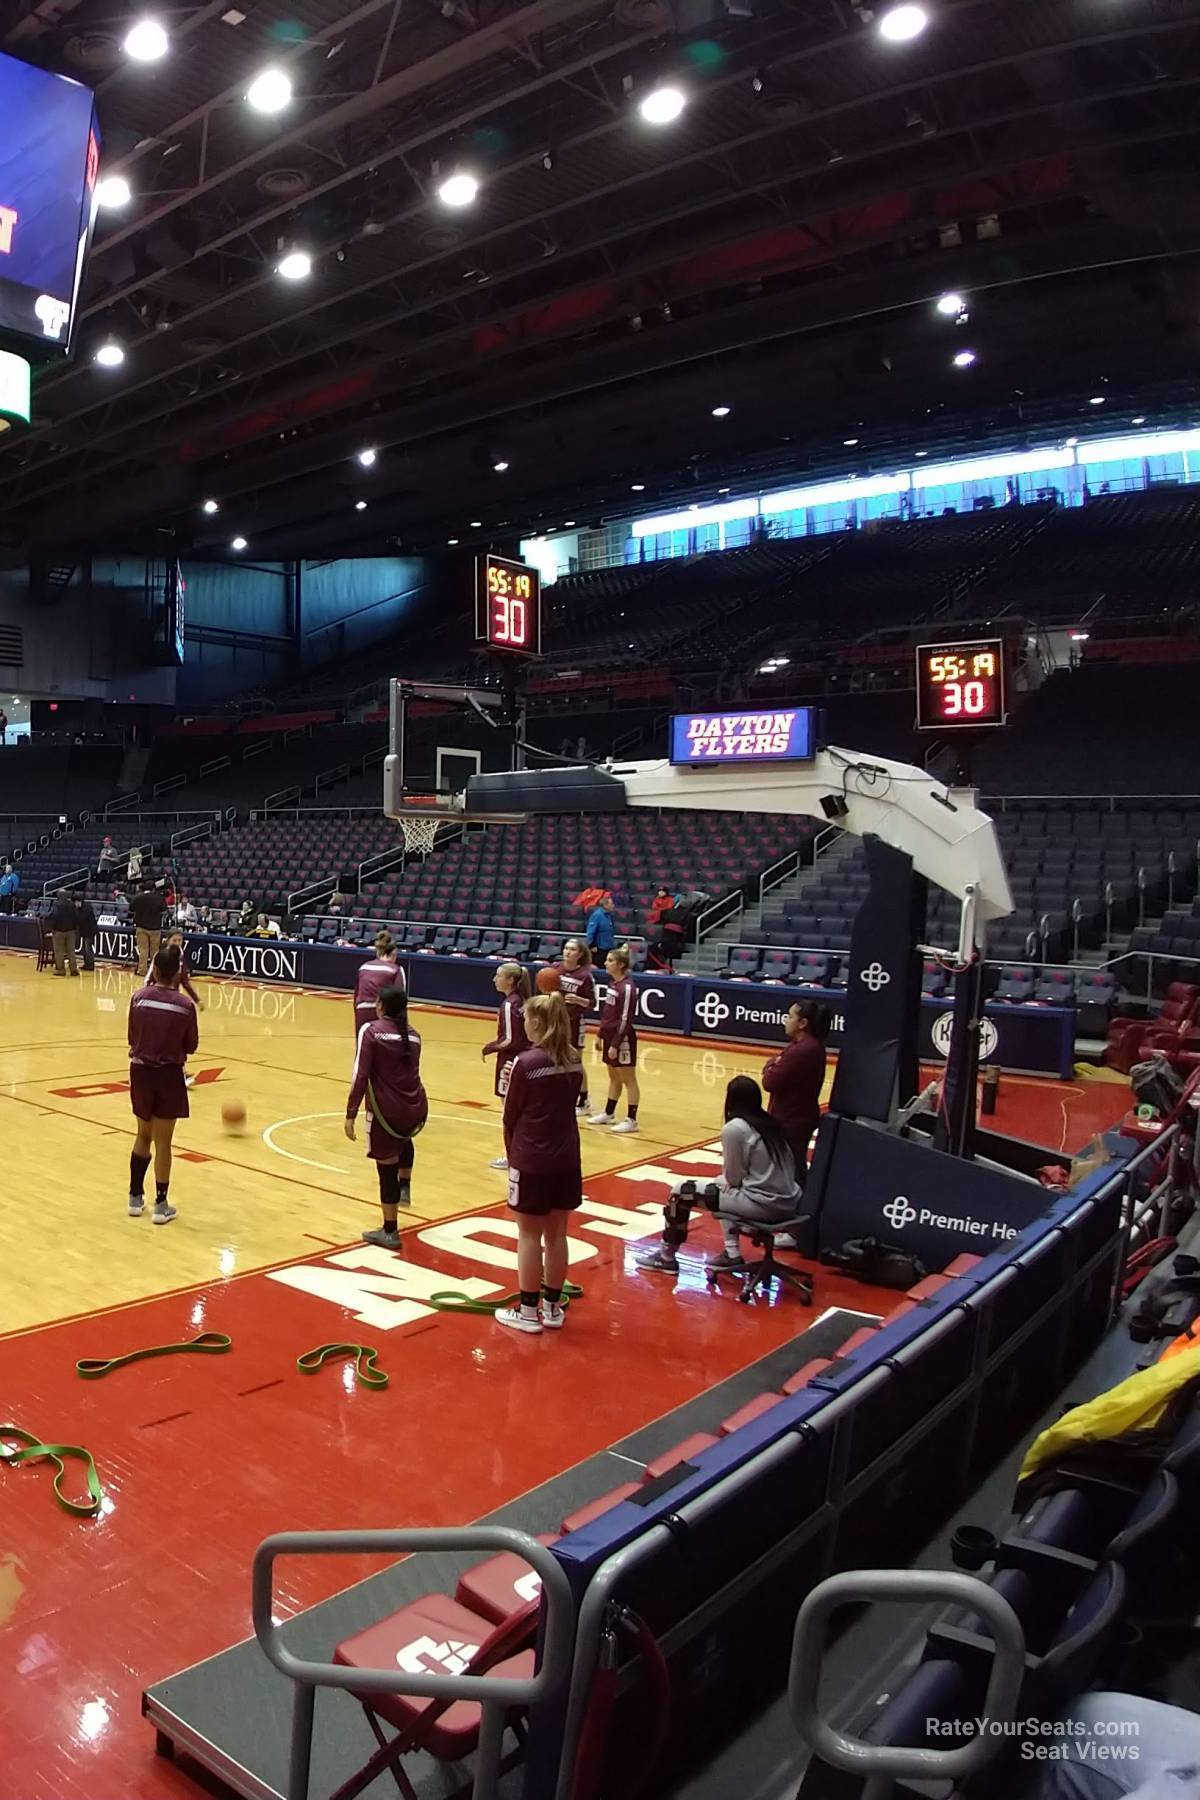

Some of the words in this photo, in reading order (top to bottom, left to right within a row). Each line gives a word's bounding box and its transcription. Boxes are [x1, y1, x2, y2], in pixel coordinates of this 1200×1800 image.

[488, 566, 530, 598] 55:19
[495, 596, 525, 643] 30
[930, 653, 995, 681] 55:19
[944, 681, 984, 714] 30
[687, 713, 796, 739] DAYTON
[690, 734, 790, 757] FLYERS
[191, 946, 203, 964] of
[207, 943, 298, 979] DAYTON
[592, 984, 665, 1018] PC
[735, 1005, 790, 1026] Premie
[919, 1208, 989, 1237] Premier
